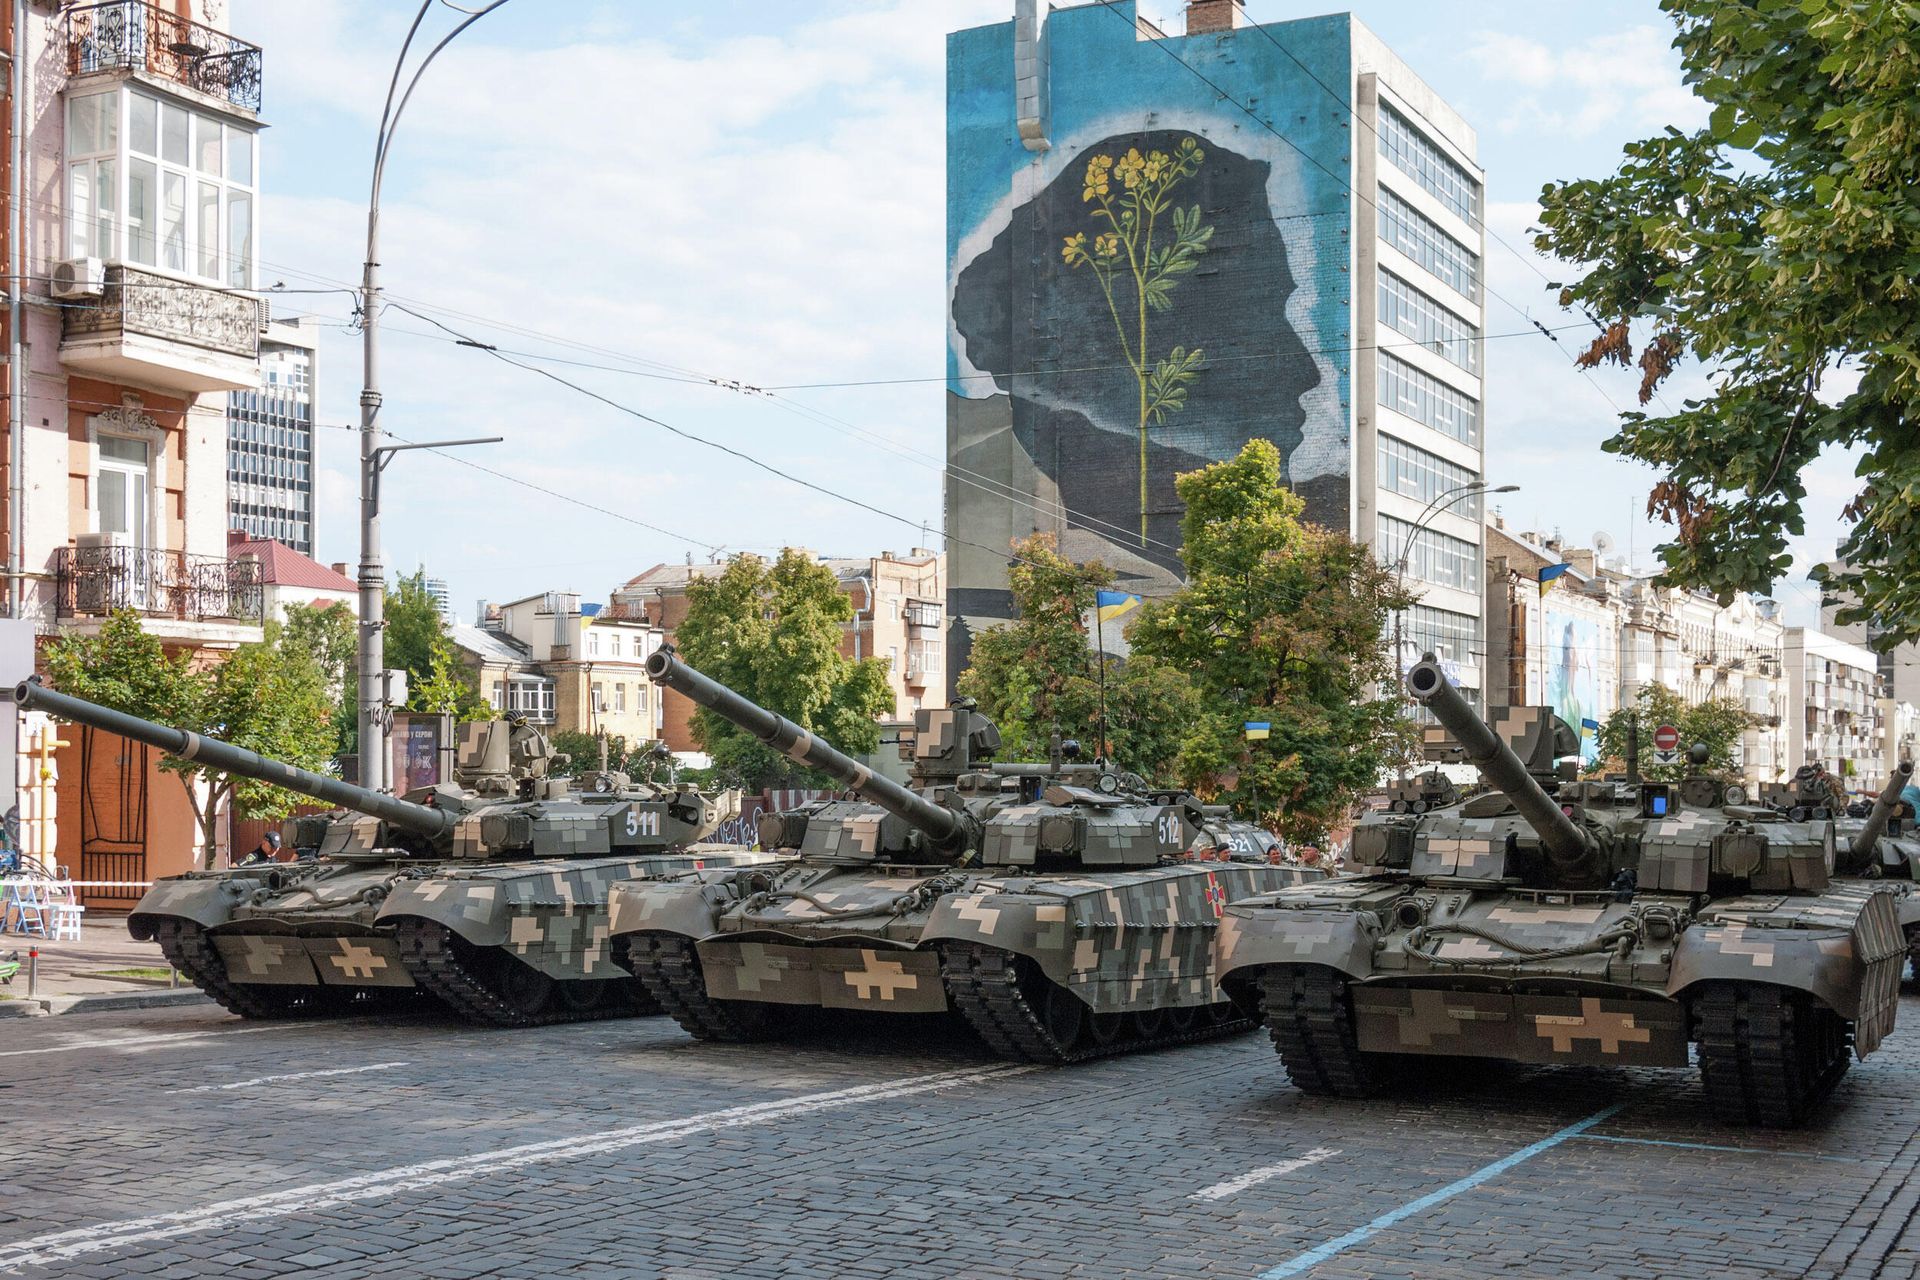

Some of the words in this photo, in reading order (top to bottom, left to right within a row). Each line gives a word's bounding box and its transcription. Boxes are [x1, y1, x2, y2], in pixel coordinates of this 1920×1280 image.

[626, 811, 657, 836] 511
[1159, 816, 1179, 844] 512
[1228, 838, 1253, 852] 521
